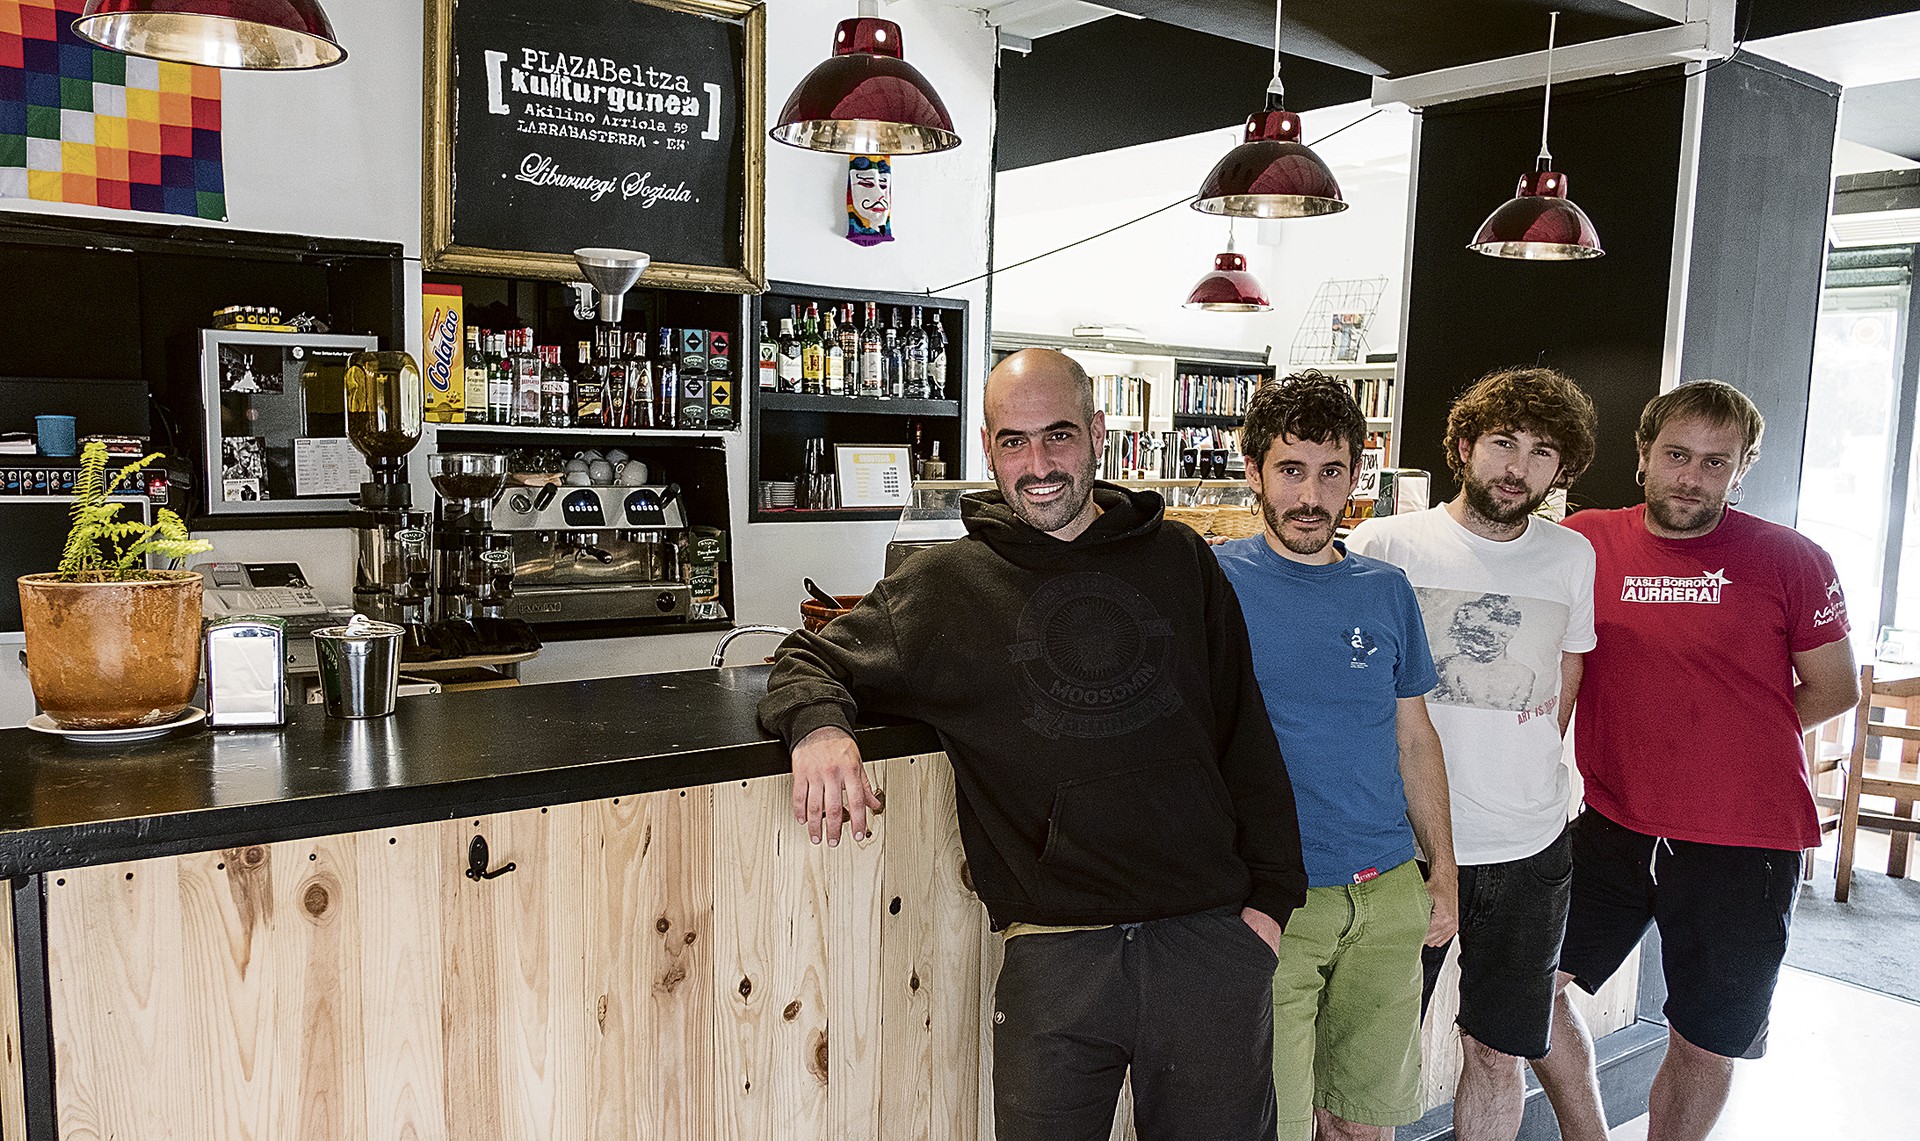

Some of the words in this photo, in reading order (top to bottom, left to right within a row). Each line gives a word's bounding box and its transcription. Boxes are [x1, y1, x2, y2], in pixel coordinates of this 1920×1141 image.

[524, 102, 596, 124] Akilino
[600, 114, 667, 133] Arriola
[673, 122, 688, 134] 59
[517, 119, 646, 149] LARRABASTERRA
[514, 152, 617, 202] Liburutegi
[621, 171, 692, 208] Soziala
[1623, 587, 1718, 602] AURRERA!
[1626, 578, 1662, 588] IKASLE
[1662, 578, 1718, 588] BORROKA
[1517, 709, 1531, 725] ART
[1534, 705, 1545, 718] IS
